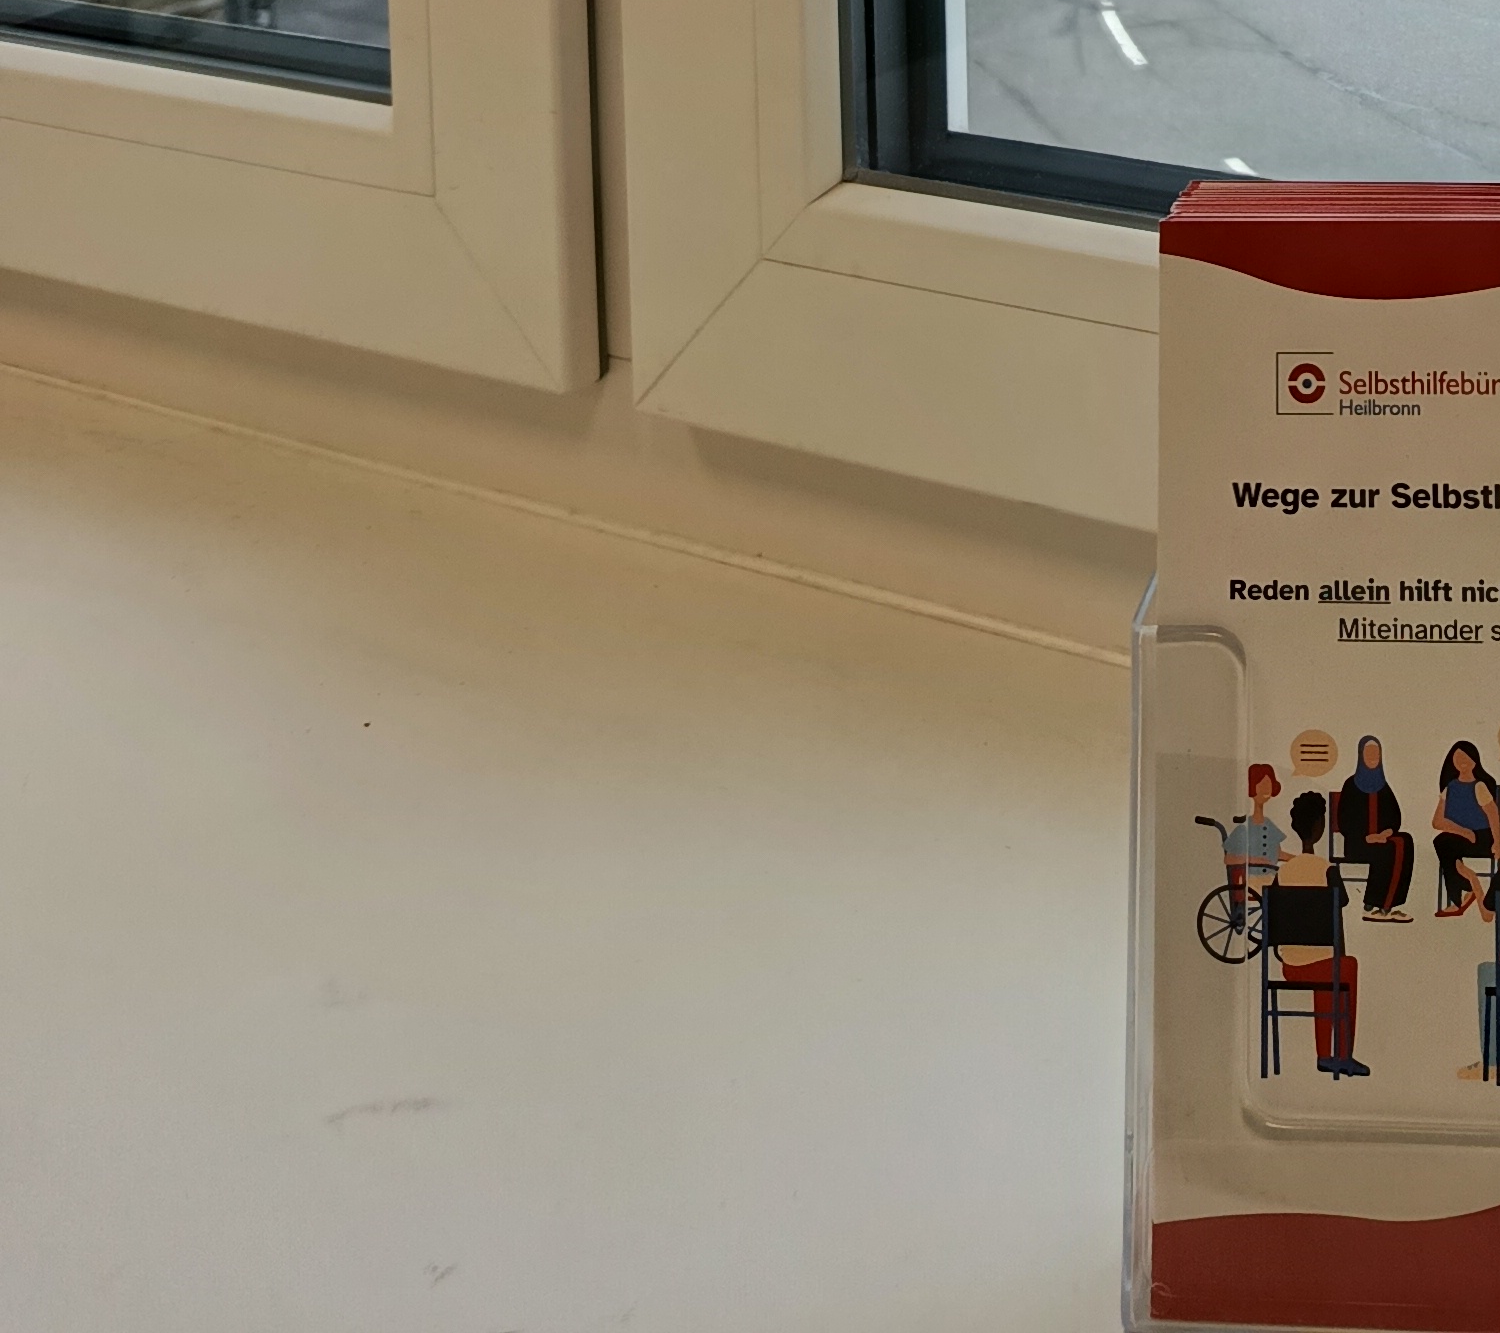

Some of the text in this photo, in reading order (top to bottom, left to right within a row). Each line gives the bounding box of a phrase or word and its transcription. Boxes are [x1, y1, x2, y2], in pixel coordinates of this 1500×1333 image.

[1338, 399, 1421, 416] Heilbronn
[1232, 482, 1320, 515] Wege
[1330, 488, 1380, 508] zur
[1229, 579, 1310, 601] Reden
[1318, 578, 1391, 604] allein
[1399, 579, 1453, 602] hilft
[1338, 617, 1484, 643] Miteinander
